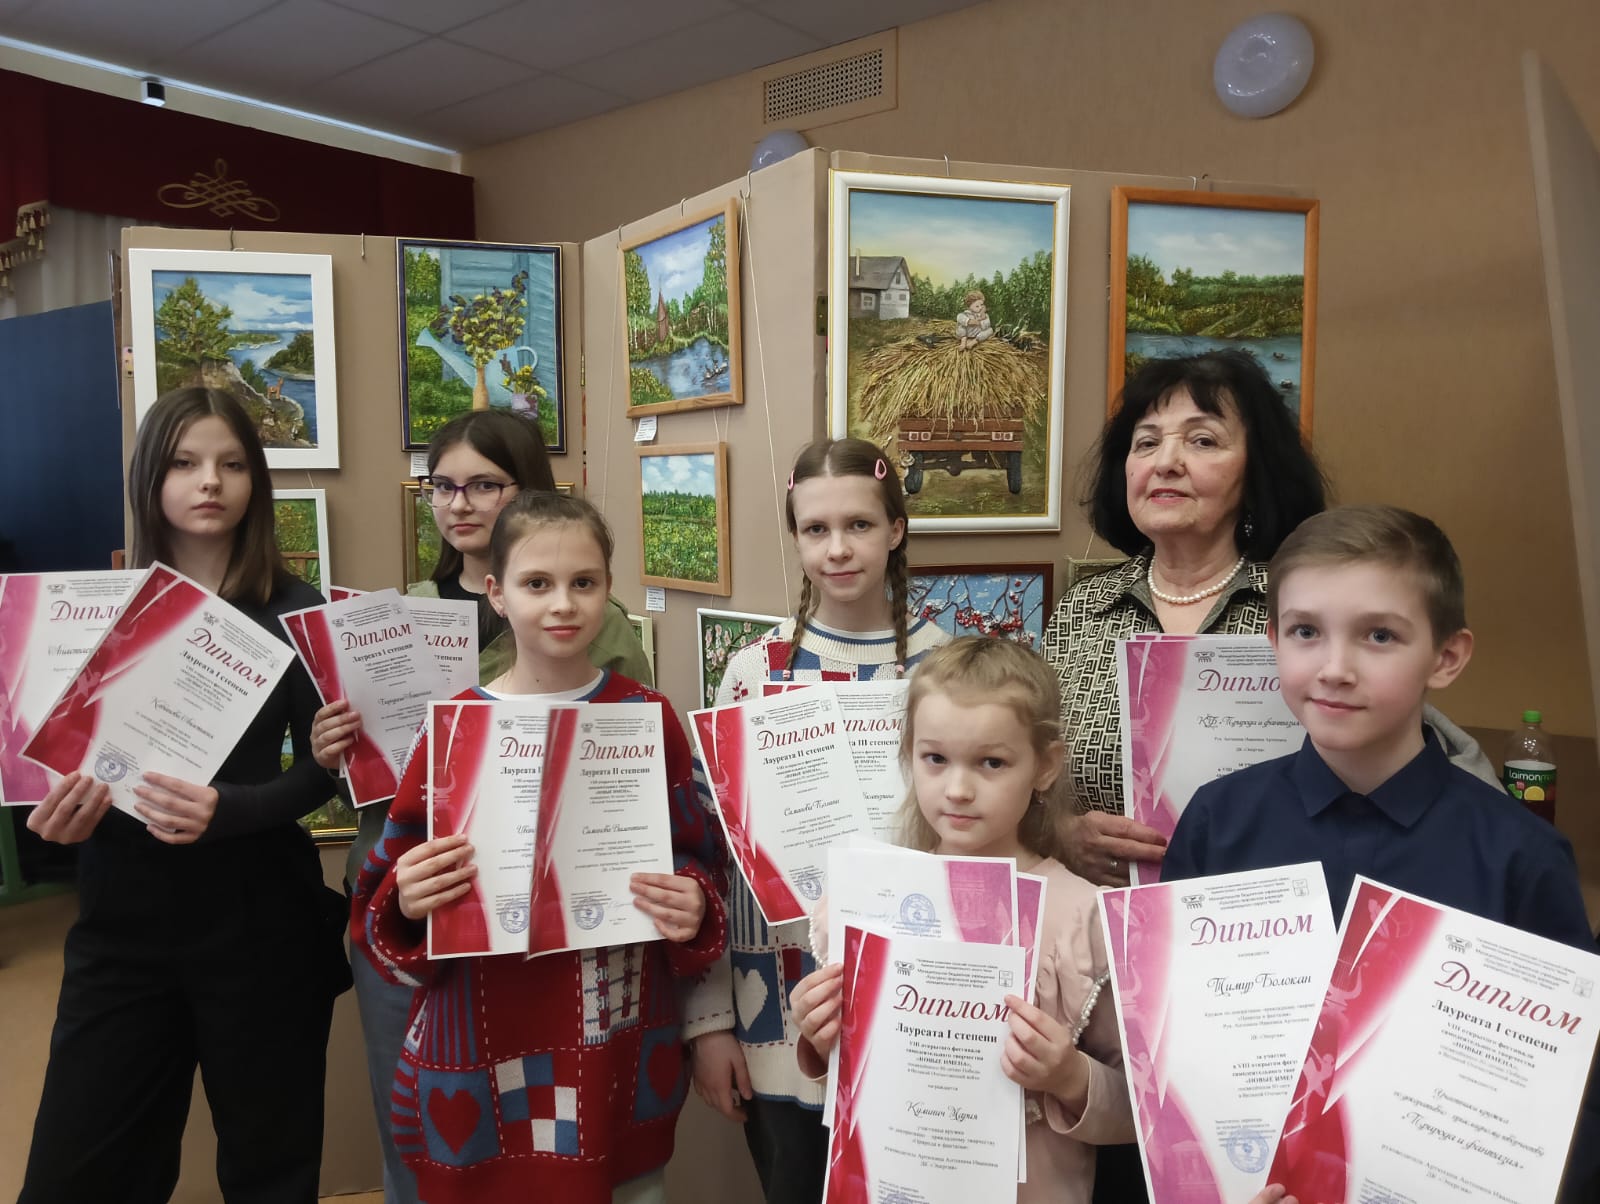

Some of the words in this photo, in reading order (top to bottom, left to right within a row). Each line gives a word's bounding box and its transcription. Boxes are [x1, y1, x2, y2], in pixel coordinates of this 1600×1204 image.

[341, 623, 412, 650] Диплом
[186, 627, 268, 689] Диплом
[1197, 669, 1280, 692] Дипло
[757, 722, 836, 750] Диплом
[843, 718, 903, 732] иплом
[579, 739, 655, 760] Диплом
[763, 753, 796, 765] Лауреата
[805, 744, 835, 756] степени
[500, 766, 536, 775] Лауреата
[1509, 769, 1541, 781] laimon
[1190, 914, 1313, 946] Диплом
[893, 984, 1010, 1022] Диплом
[1434, 961, 1583, 1036] Диплом
[896, 1022, 944, 1038] Лауреата
[947, 1030, 951, 1038] I
[954, 1032, 997, 1043] степени
[1432, 999, 1492, 1029] Лауреата
[1496, 1022, 1502, 1033] I
[1504, 1027, 1558, 1054] степени
